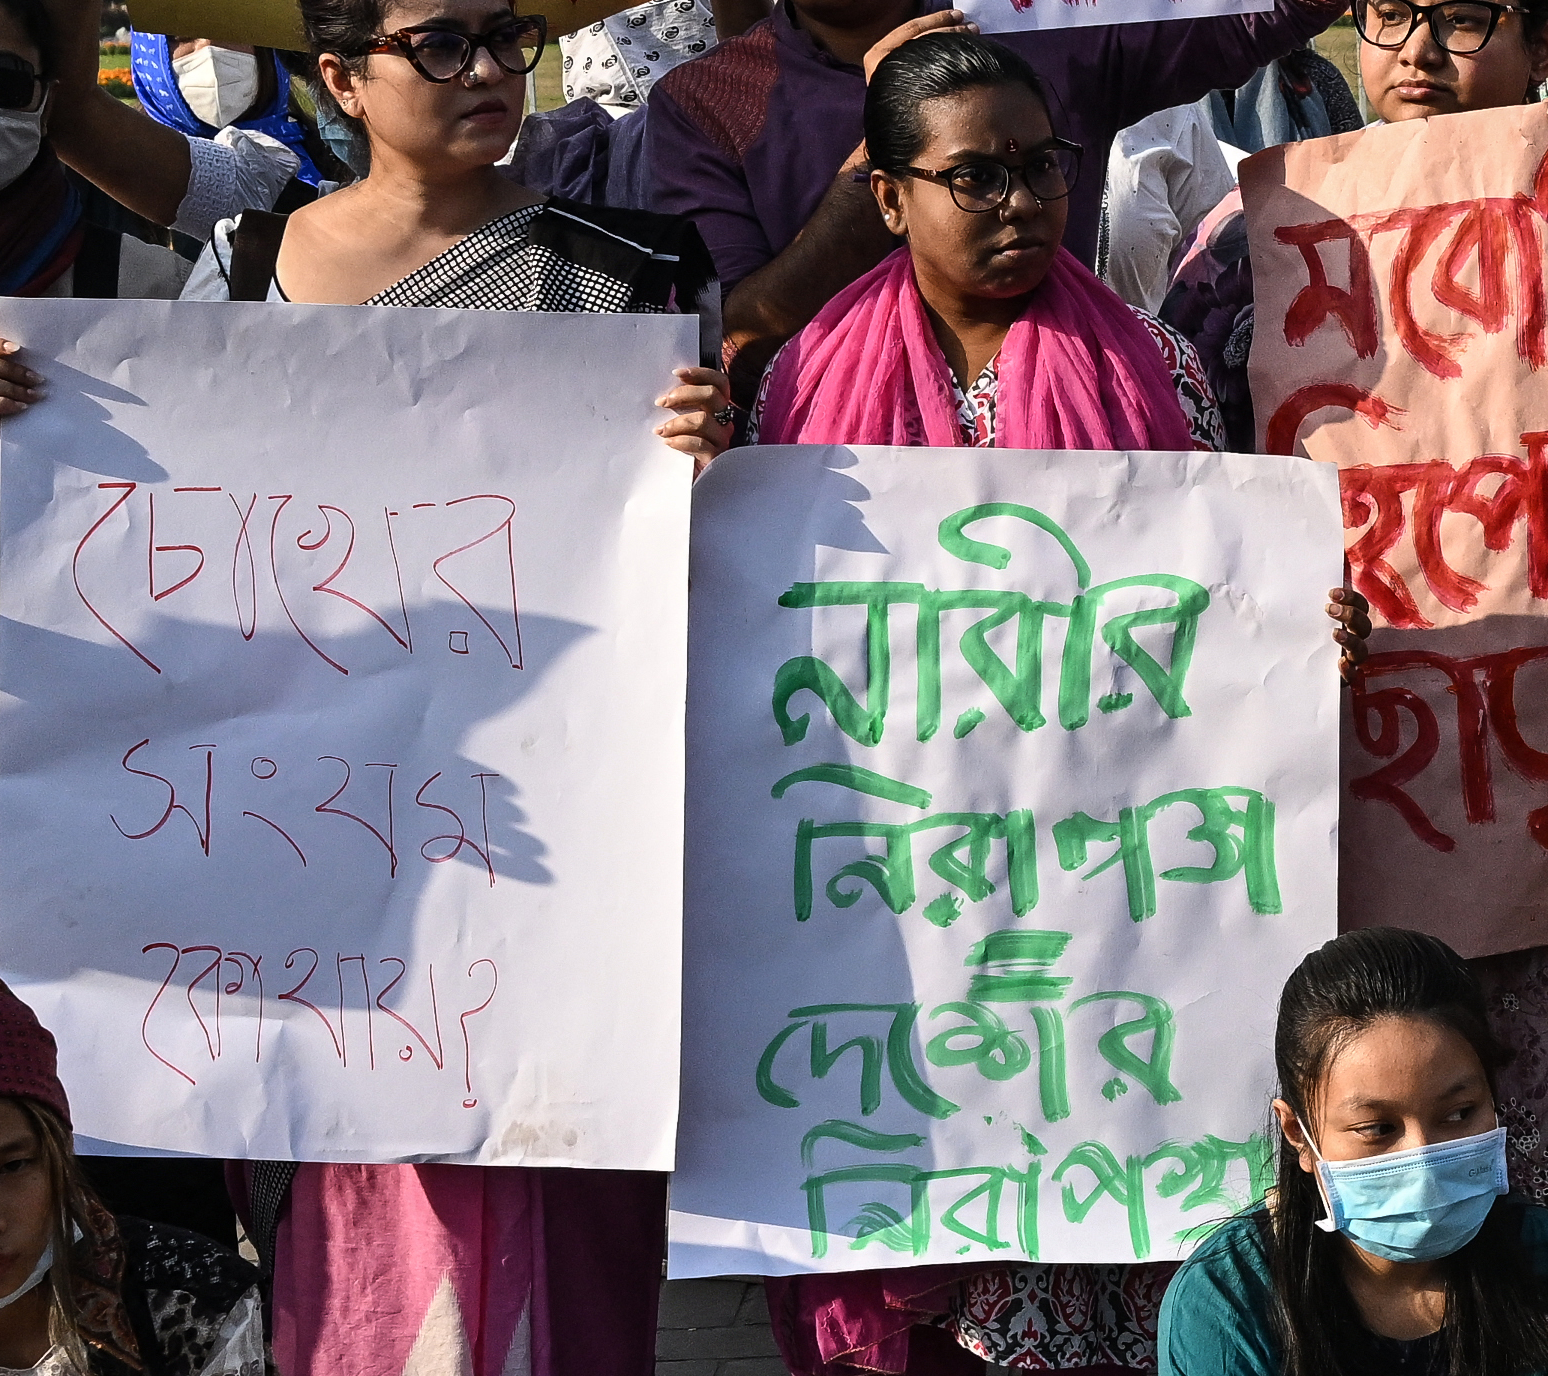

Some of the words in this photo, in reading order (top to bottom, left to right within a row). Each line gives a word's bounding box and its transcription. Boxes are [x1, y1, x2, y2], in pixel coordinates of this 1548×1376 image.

[73, 482, 525, 674] চোখের
[772, 501, 1210, 746] নারীর
[109, 738, 501, 888] সংযম
